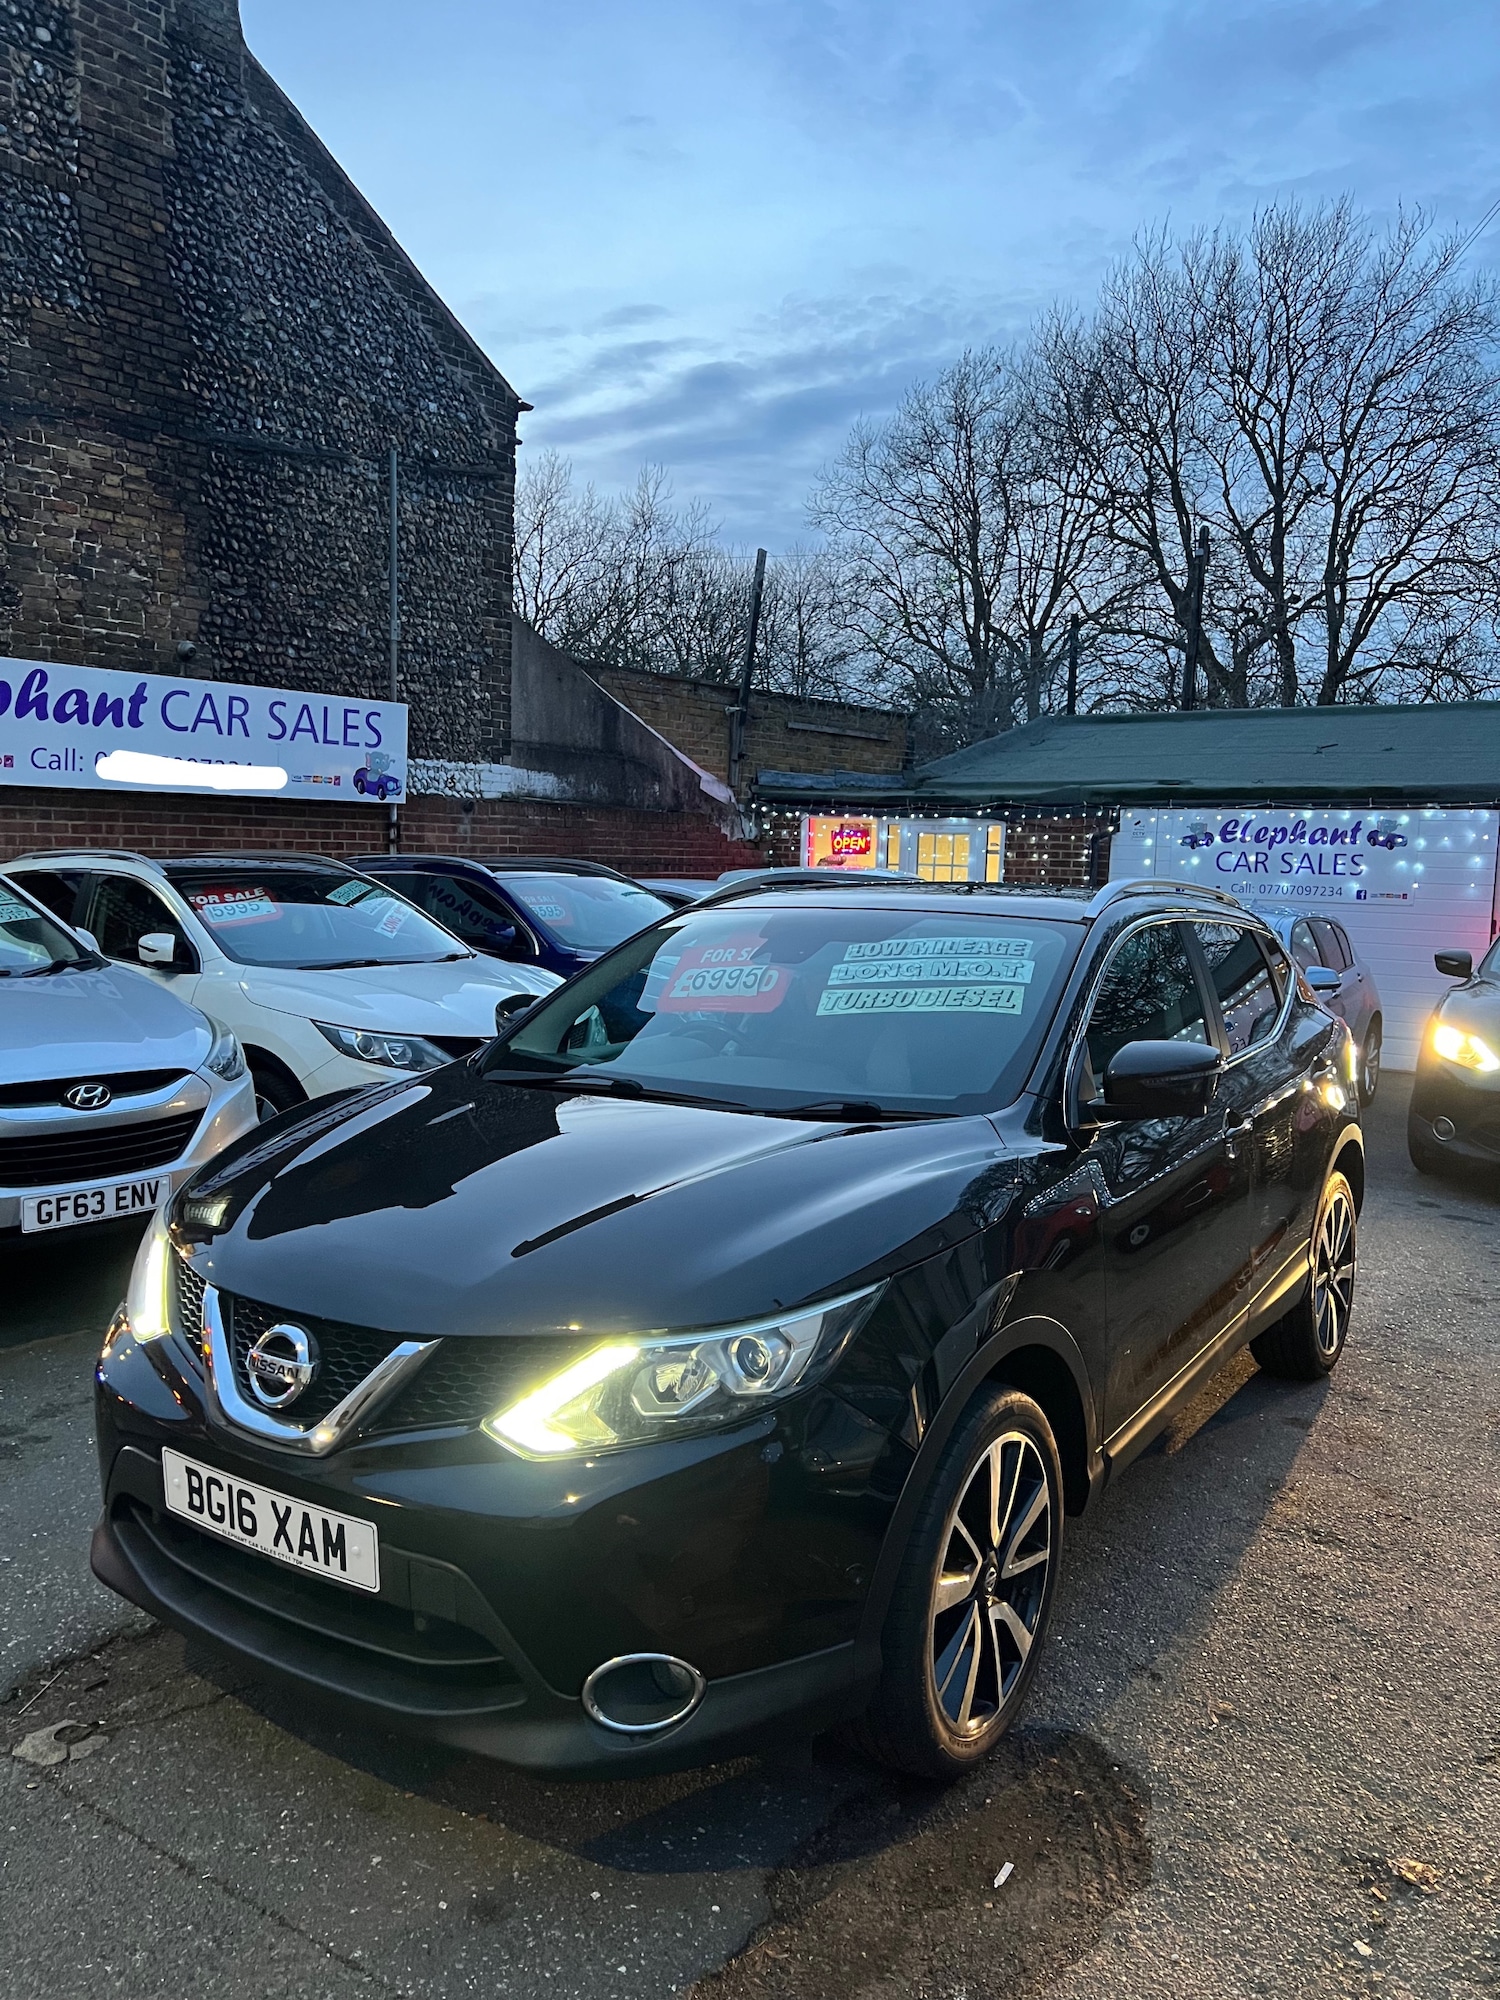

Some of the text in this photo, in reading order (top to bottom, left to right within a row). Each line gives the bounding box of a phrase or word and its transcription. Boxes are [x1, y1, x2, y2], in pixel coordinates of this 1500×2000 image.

[160, 689, 251, 738] CAR
[267, 701, 383, 749] SALES
[30, 747, 84, 772] Call:
[833, 836, 866, 849] OPEN
[1219, 818, 1363, 851] Elephant
[1215, 851, 1365, 876] CAR SALES
[223, 886, 266, 902] SALE
[1230, 883, 1344, 897] Call: 07707097234
[212, 903, 260, 918] 5995
[700, 948, 736, 964] FOR
[850, 940, 1027, 959] LOW MILEAGE
[837, 960, 1025, 981] LONG M.O.T
[824, 987, 1017, 1011] TURBO DIESEL
[36, 1190, 105, 1225] GF63
[115, 1180, 160, 1211] ENV
[251, 1354, 300, 1378] NISSAN
[185, 1465, 347, 1573] BG16 XAM
[248, 1540, 259, 1550] CAR
[259, 1545, 277, 1556] SALES
